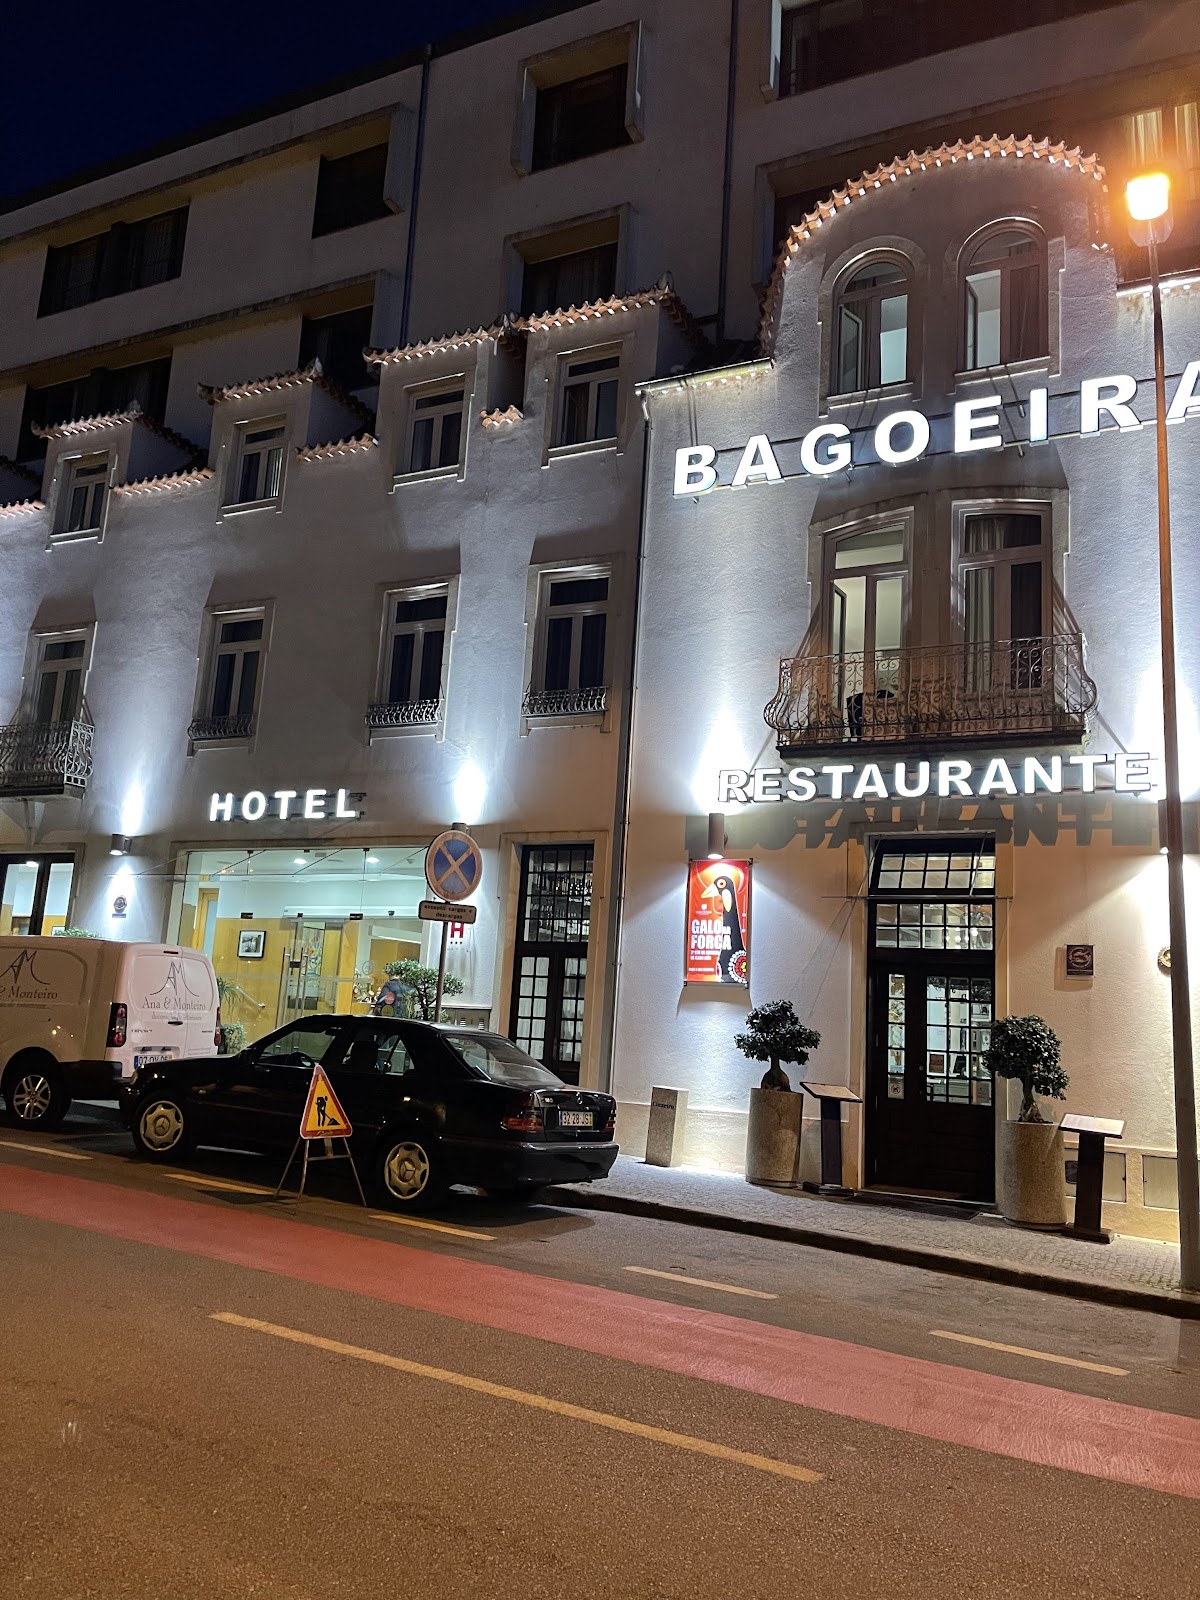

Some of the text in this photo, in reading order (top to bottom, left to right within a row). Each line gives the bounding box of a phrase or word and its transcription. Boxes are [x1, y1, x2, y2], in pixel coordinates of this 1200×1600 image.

[673, 360, 1200, 498] BAGOEIRA
[718, 752, 1153, 804] RESTAURANTE
[209, 788, 357, 822] HOTEL
[450, 921, 464, 938] H
[691, 919, 722, 935] GALO
[8, 985, 58, 999] Monteiro
[142, 996, 206, 1011] Ana & Monteiro
